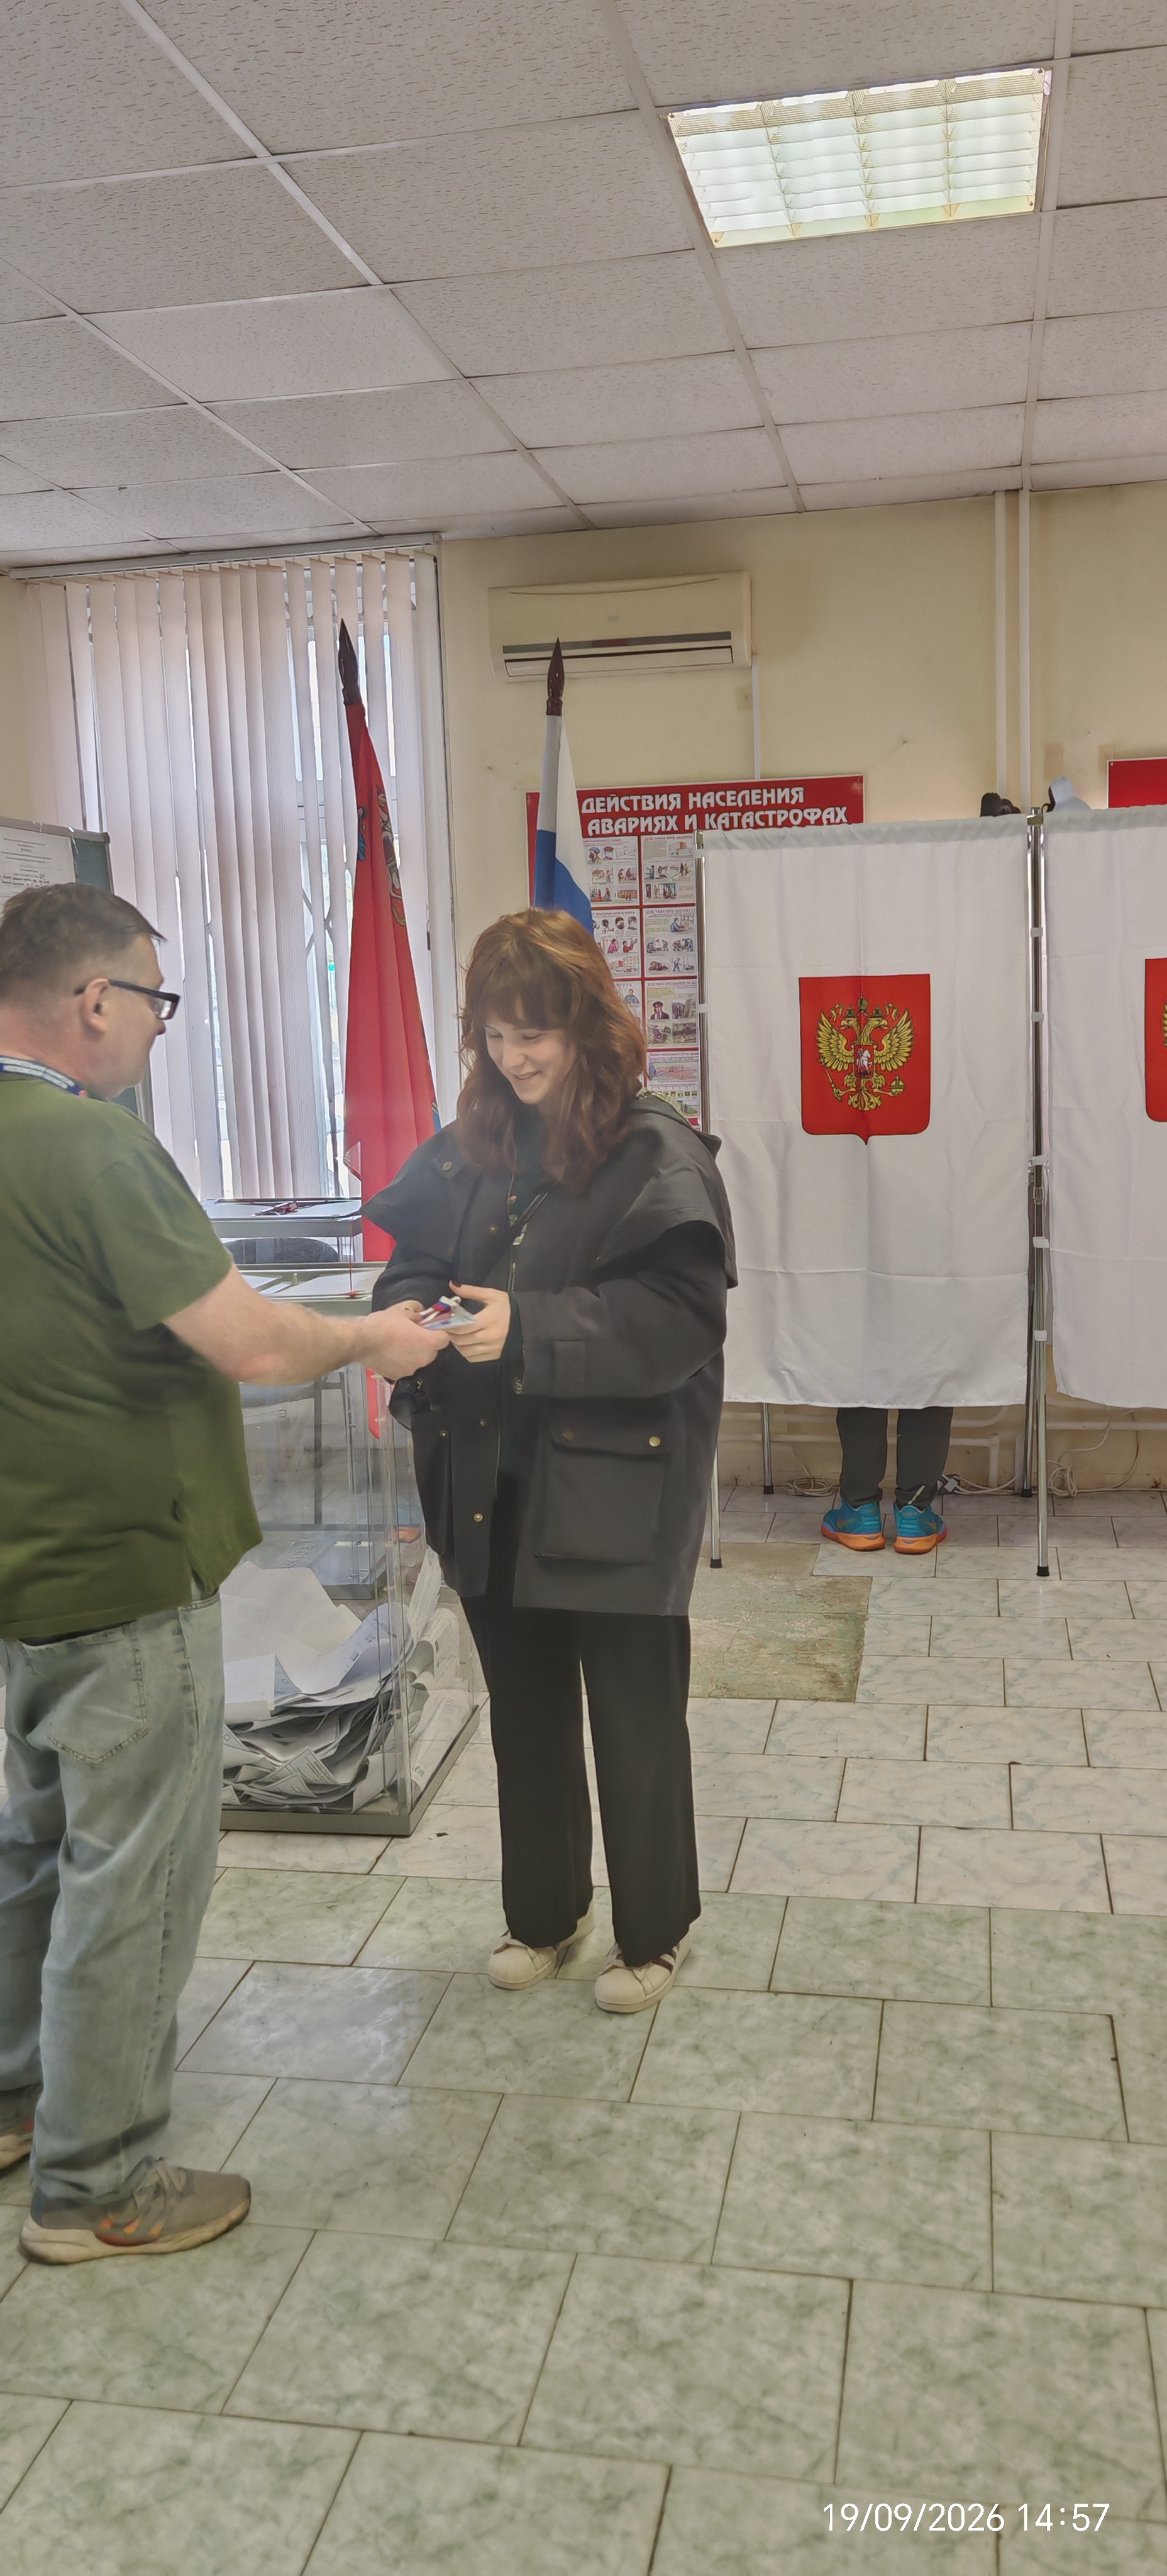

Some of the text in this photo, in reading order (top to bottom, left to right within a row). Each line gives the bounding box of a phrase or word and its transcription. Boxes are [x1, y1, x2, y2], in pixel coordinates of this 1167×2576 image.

[581, 787, 804, 814] ДЕЙСТВИЯ НАСЕЛЕНИЯ
[587, 806, 848, 836] АВАРИЯХ И КАТАСТРОФАХ
